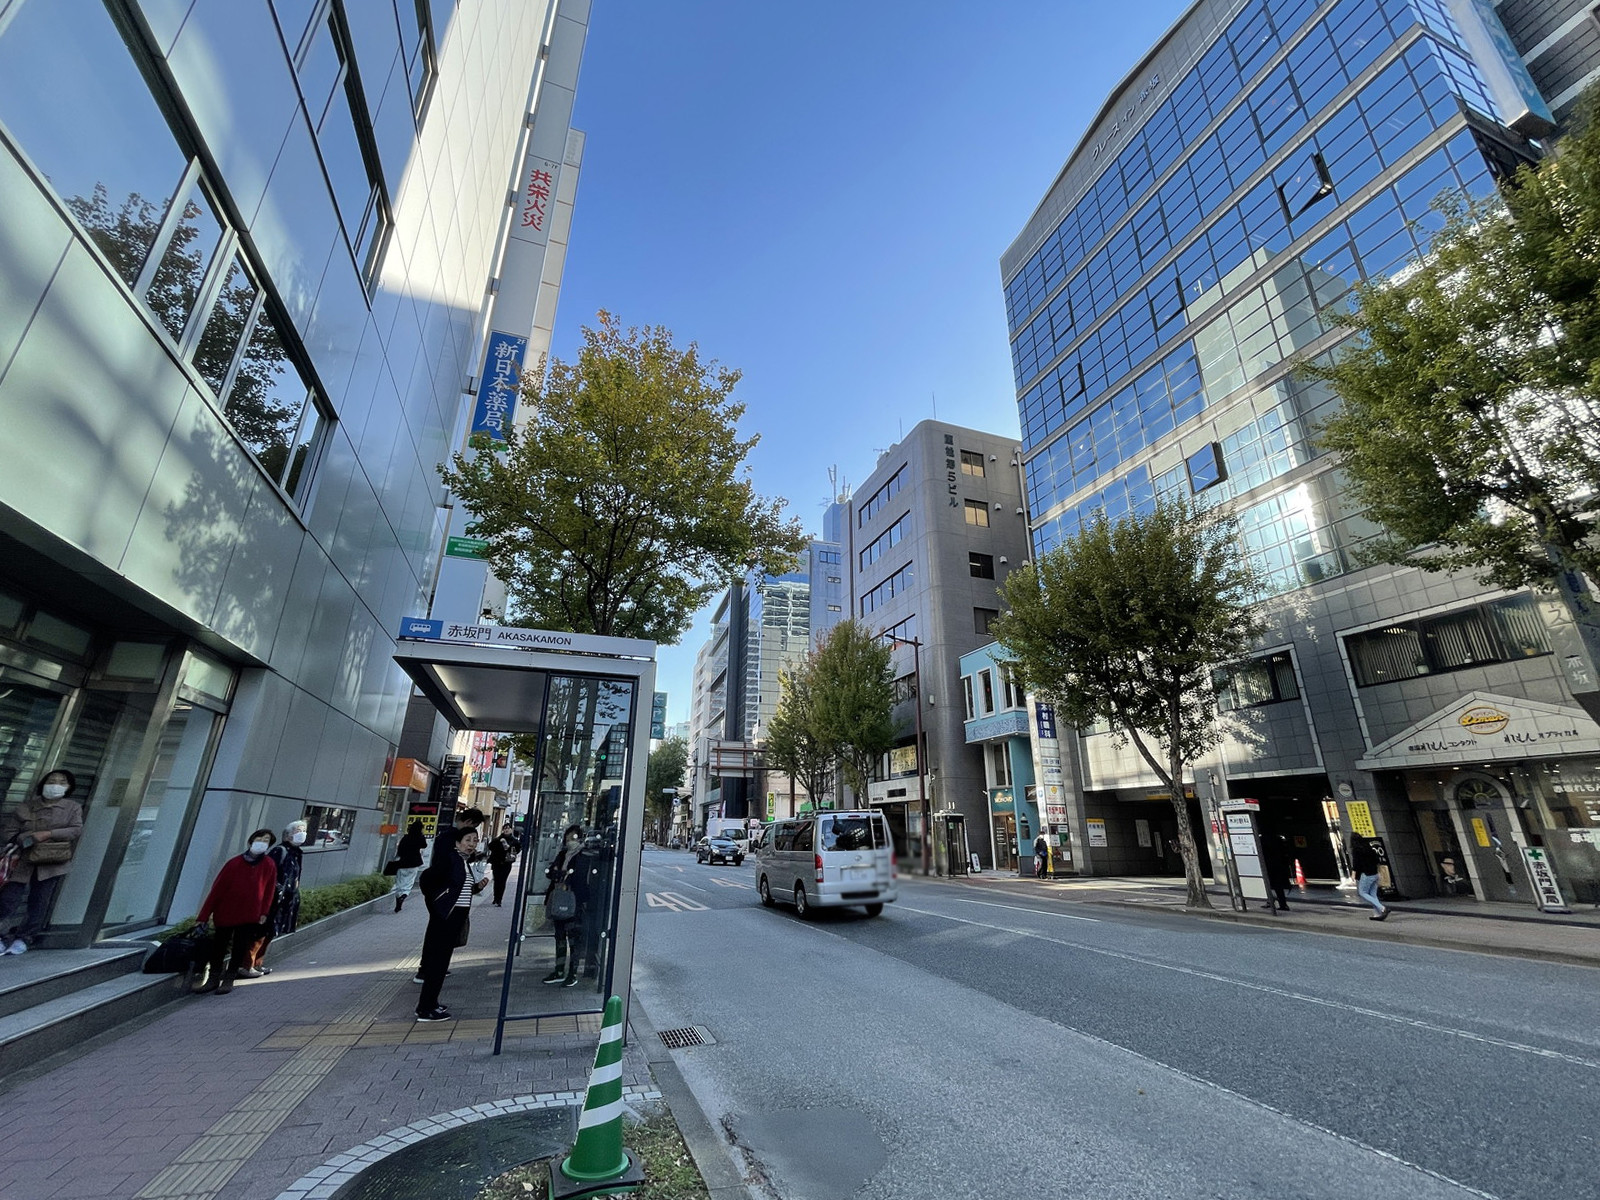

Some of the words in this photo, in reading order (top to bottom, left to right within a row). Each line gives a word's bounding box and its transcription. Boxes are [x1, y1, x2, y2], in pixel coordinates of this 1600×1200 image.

[521, 169, 552, 232] 共栄火災
[479, 340, 519, 432] 新日本薬局
[447, 624, 491, 641] 赤坂門
[497, 631, 572, 646] AKASAKAMON
[1532, 861, 1560, 904] 赤坂門薬局
[645, 891, 712, 913] 40
